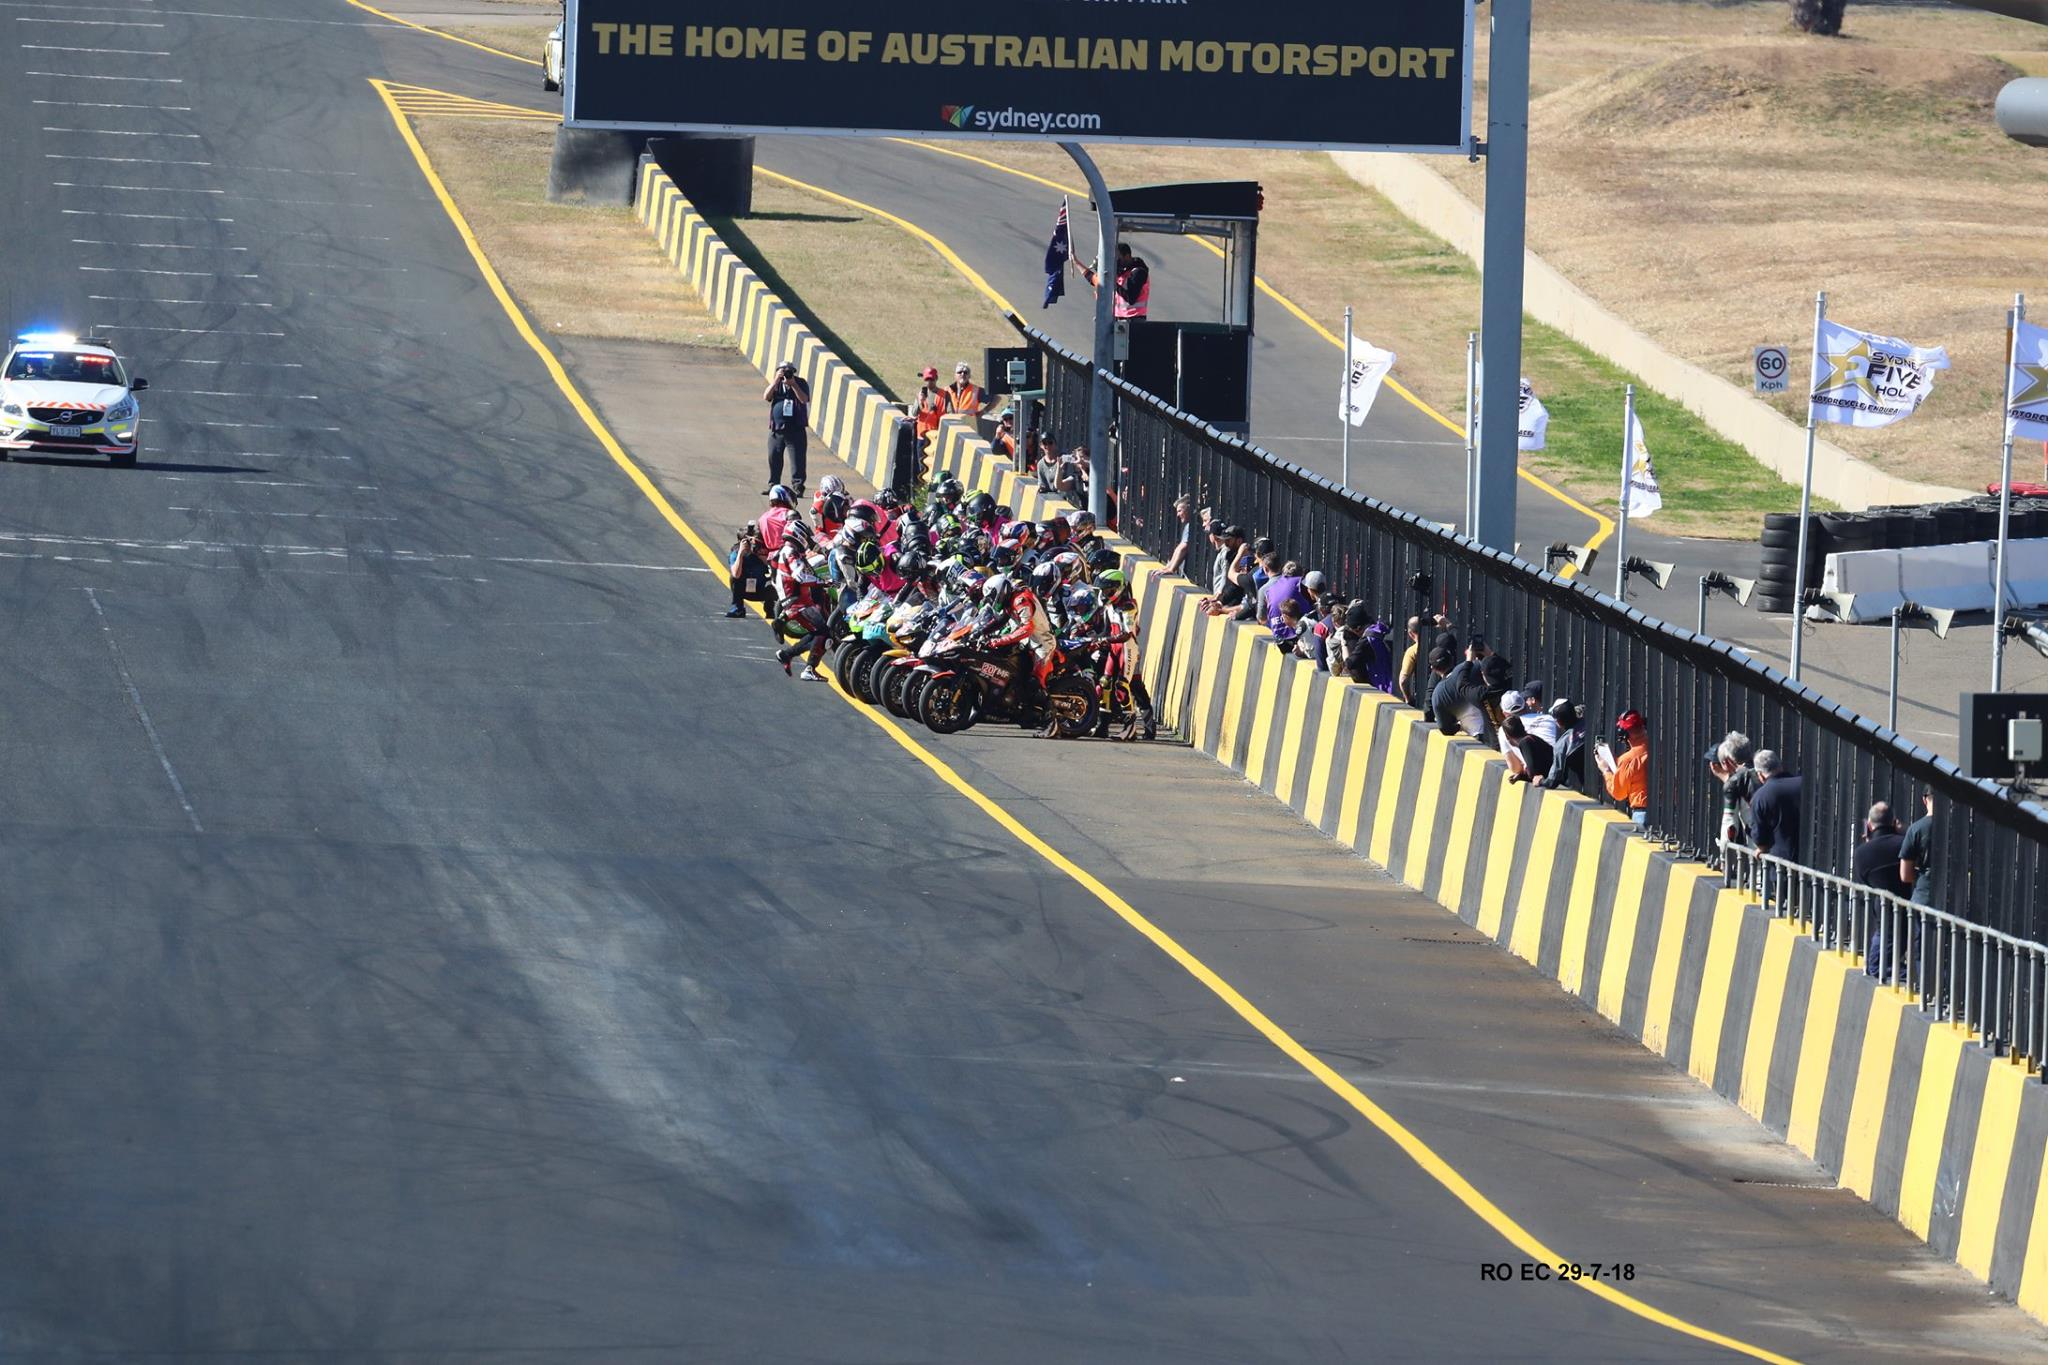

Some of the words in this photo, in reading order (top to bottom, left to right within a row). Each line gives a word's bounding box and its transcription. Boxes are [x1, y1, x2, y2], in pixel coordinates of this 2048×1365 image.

[592, 22, 674, 57] THE
[685, 26, 807, 61] HOME
[817, 30, 873, 63] OF
[881, 32, 1149, 71] AUSTRALIAN
[1160, 40, 1455, 79] MOTORSPORT
[974, 107, 1101, 132] sydney.com
[1760, 357, 1783, 370] 60
[1872, 351, 1920, 373] SYDNE
[1866, 363, 1921, 389] FIVE
[1875, 385, 1907, 398] HOU
